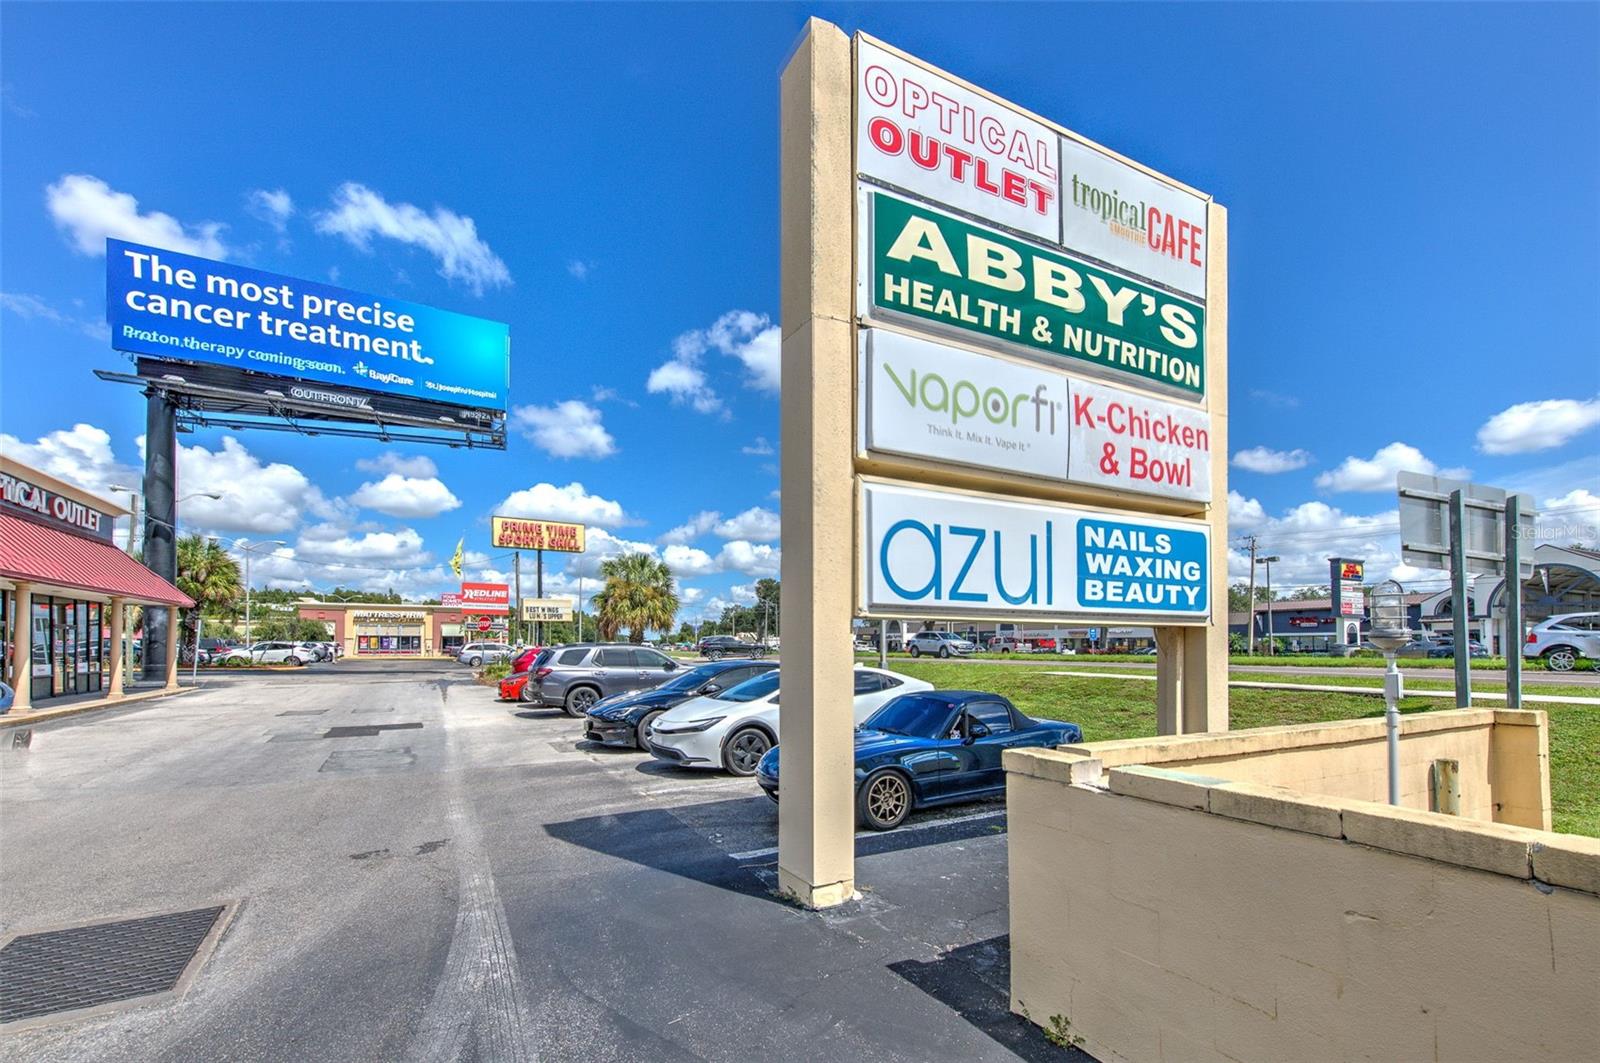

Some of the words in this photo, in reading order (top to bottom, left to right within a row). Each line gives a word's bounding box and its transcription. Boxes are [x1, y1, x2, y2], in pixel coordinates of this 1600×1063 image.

[865, 65, 1057, 181] OPTICAL
[867, 116, 1057, 216] OUTLET
[1072, 174, 1147, 232] tropical
[1147, 207, 1203, 268] CAFE
[124, 250, 197, 290] The
[206, 274, 294, 309] most
[303, 293, 415, 333] precise
[886, 215, 1198, 349] ABBY'S
[126, 290, 252, 331] cancer
[258, 310, 434, 365] treatment.
[183, 335, 245, 360] therapy
[883, 273, 1022, 335] HEALTH
[1031, 316, 1053, 345] &
[1063, 324, 1200, 389] NUTRITION
[883, 362, 1056, 436] vaporfi
[1073, 393, 1210, 452] K-Chicken
[927, 423, 953, 438] Think
[966, 431, 983, 444] Mix
[995, 437, 1017, 451] Vape
[1099, 442, 1120, 476] &
[1129, 447, 1192, 488] Bowl
[53, 496, 102, 532] OUTLET
[1085, 525, 1172, 553] NAILS
[880, 519, 1053, 605] azul
[1085, 553, 1201, 581] WAXING
[1085, 579, 1201, 606] BEAUTY
